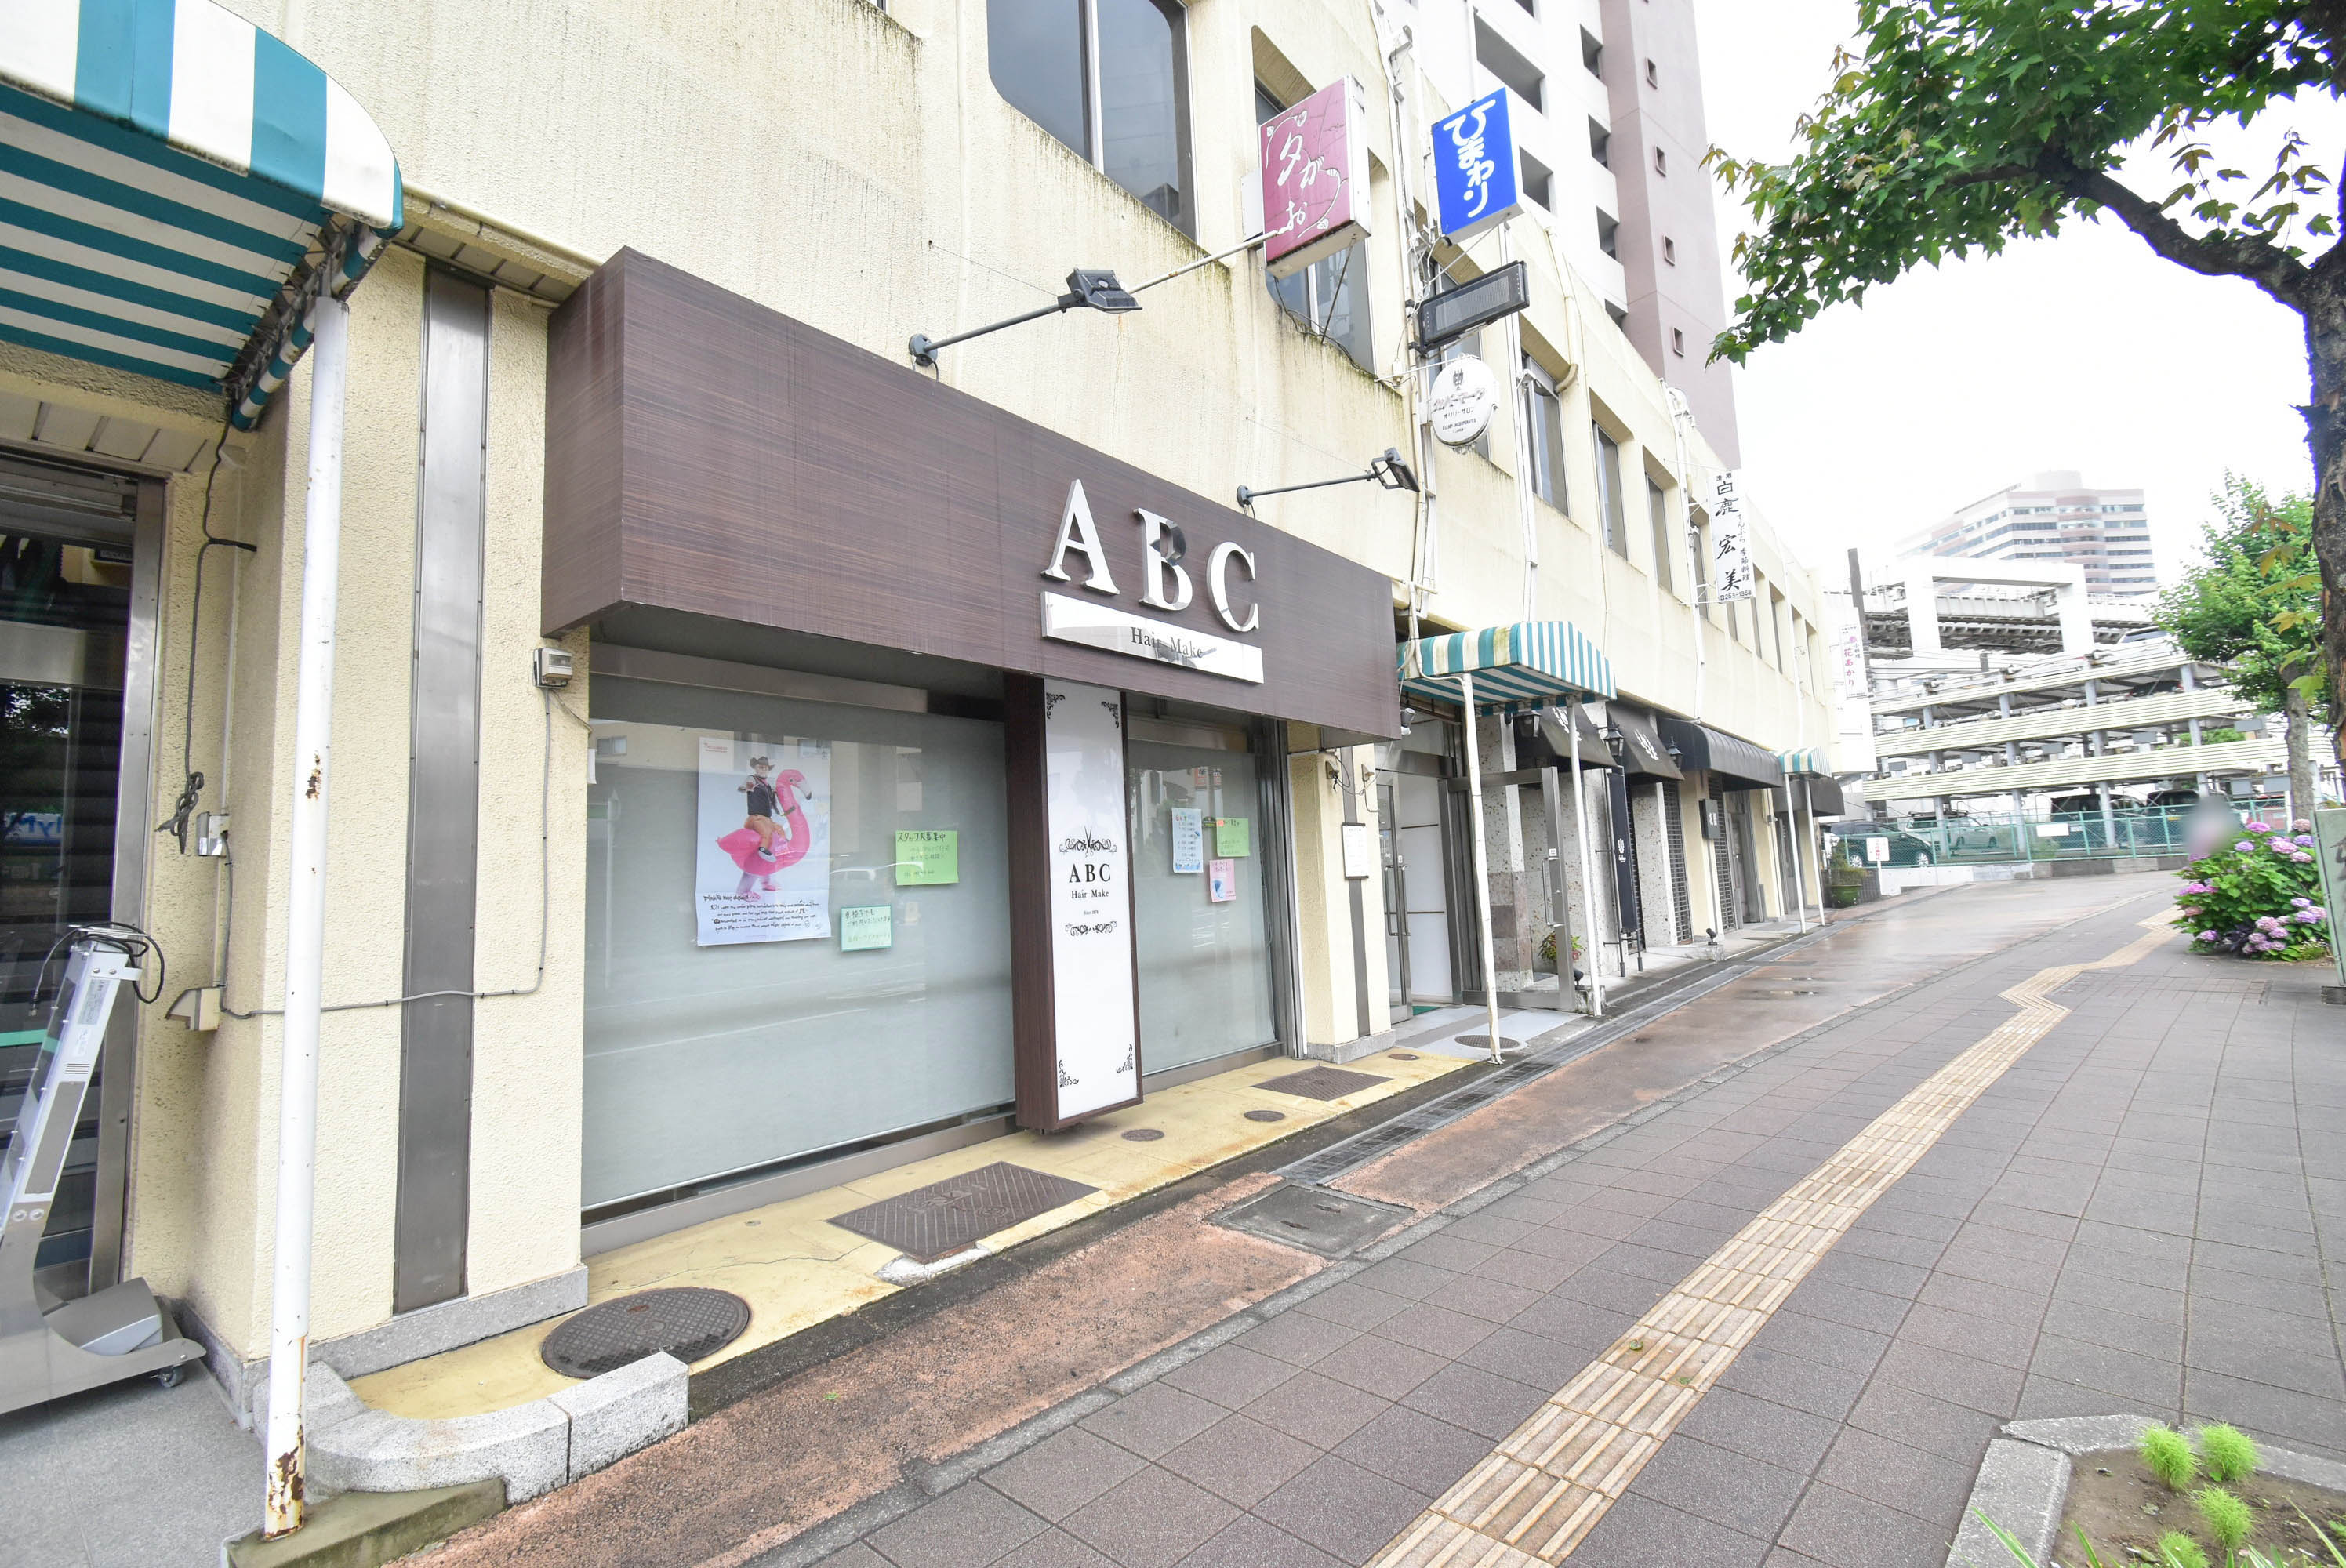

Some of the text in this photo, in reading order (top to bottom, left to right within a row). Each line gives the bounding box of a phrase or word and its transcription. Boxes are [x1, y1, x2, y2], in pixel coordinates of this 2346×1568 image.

[1443, 99, 1497, 218] ひまわり
[1714, 481, 1739, 517] 白鹿
[1040, 478, 1260, 632] ABC
[1130, 626, 1204, 659] Hair Make
[1069, 863, 1111, 884] ABC
[1071, 888, 1109, 899] Hair Make
